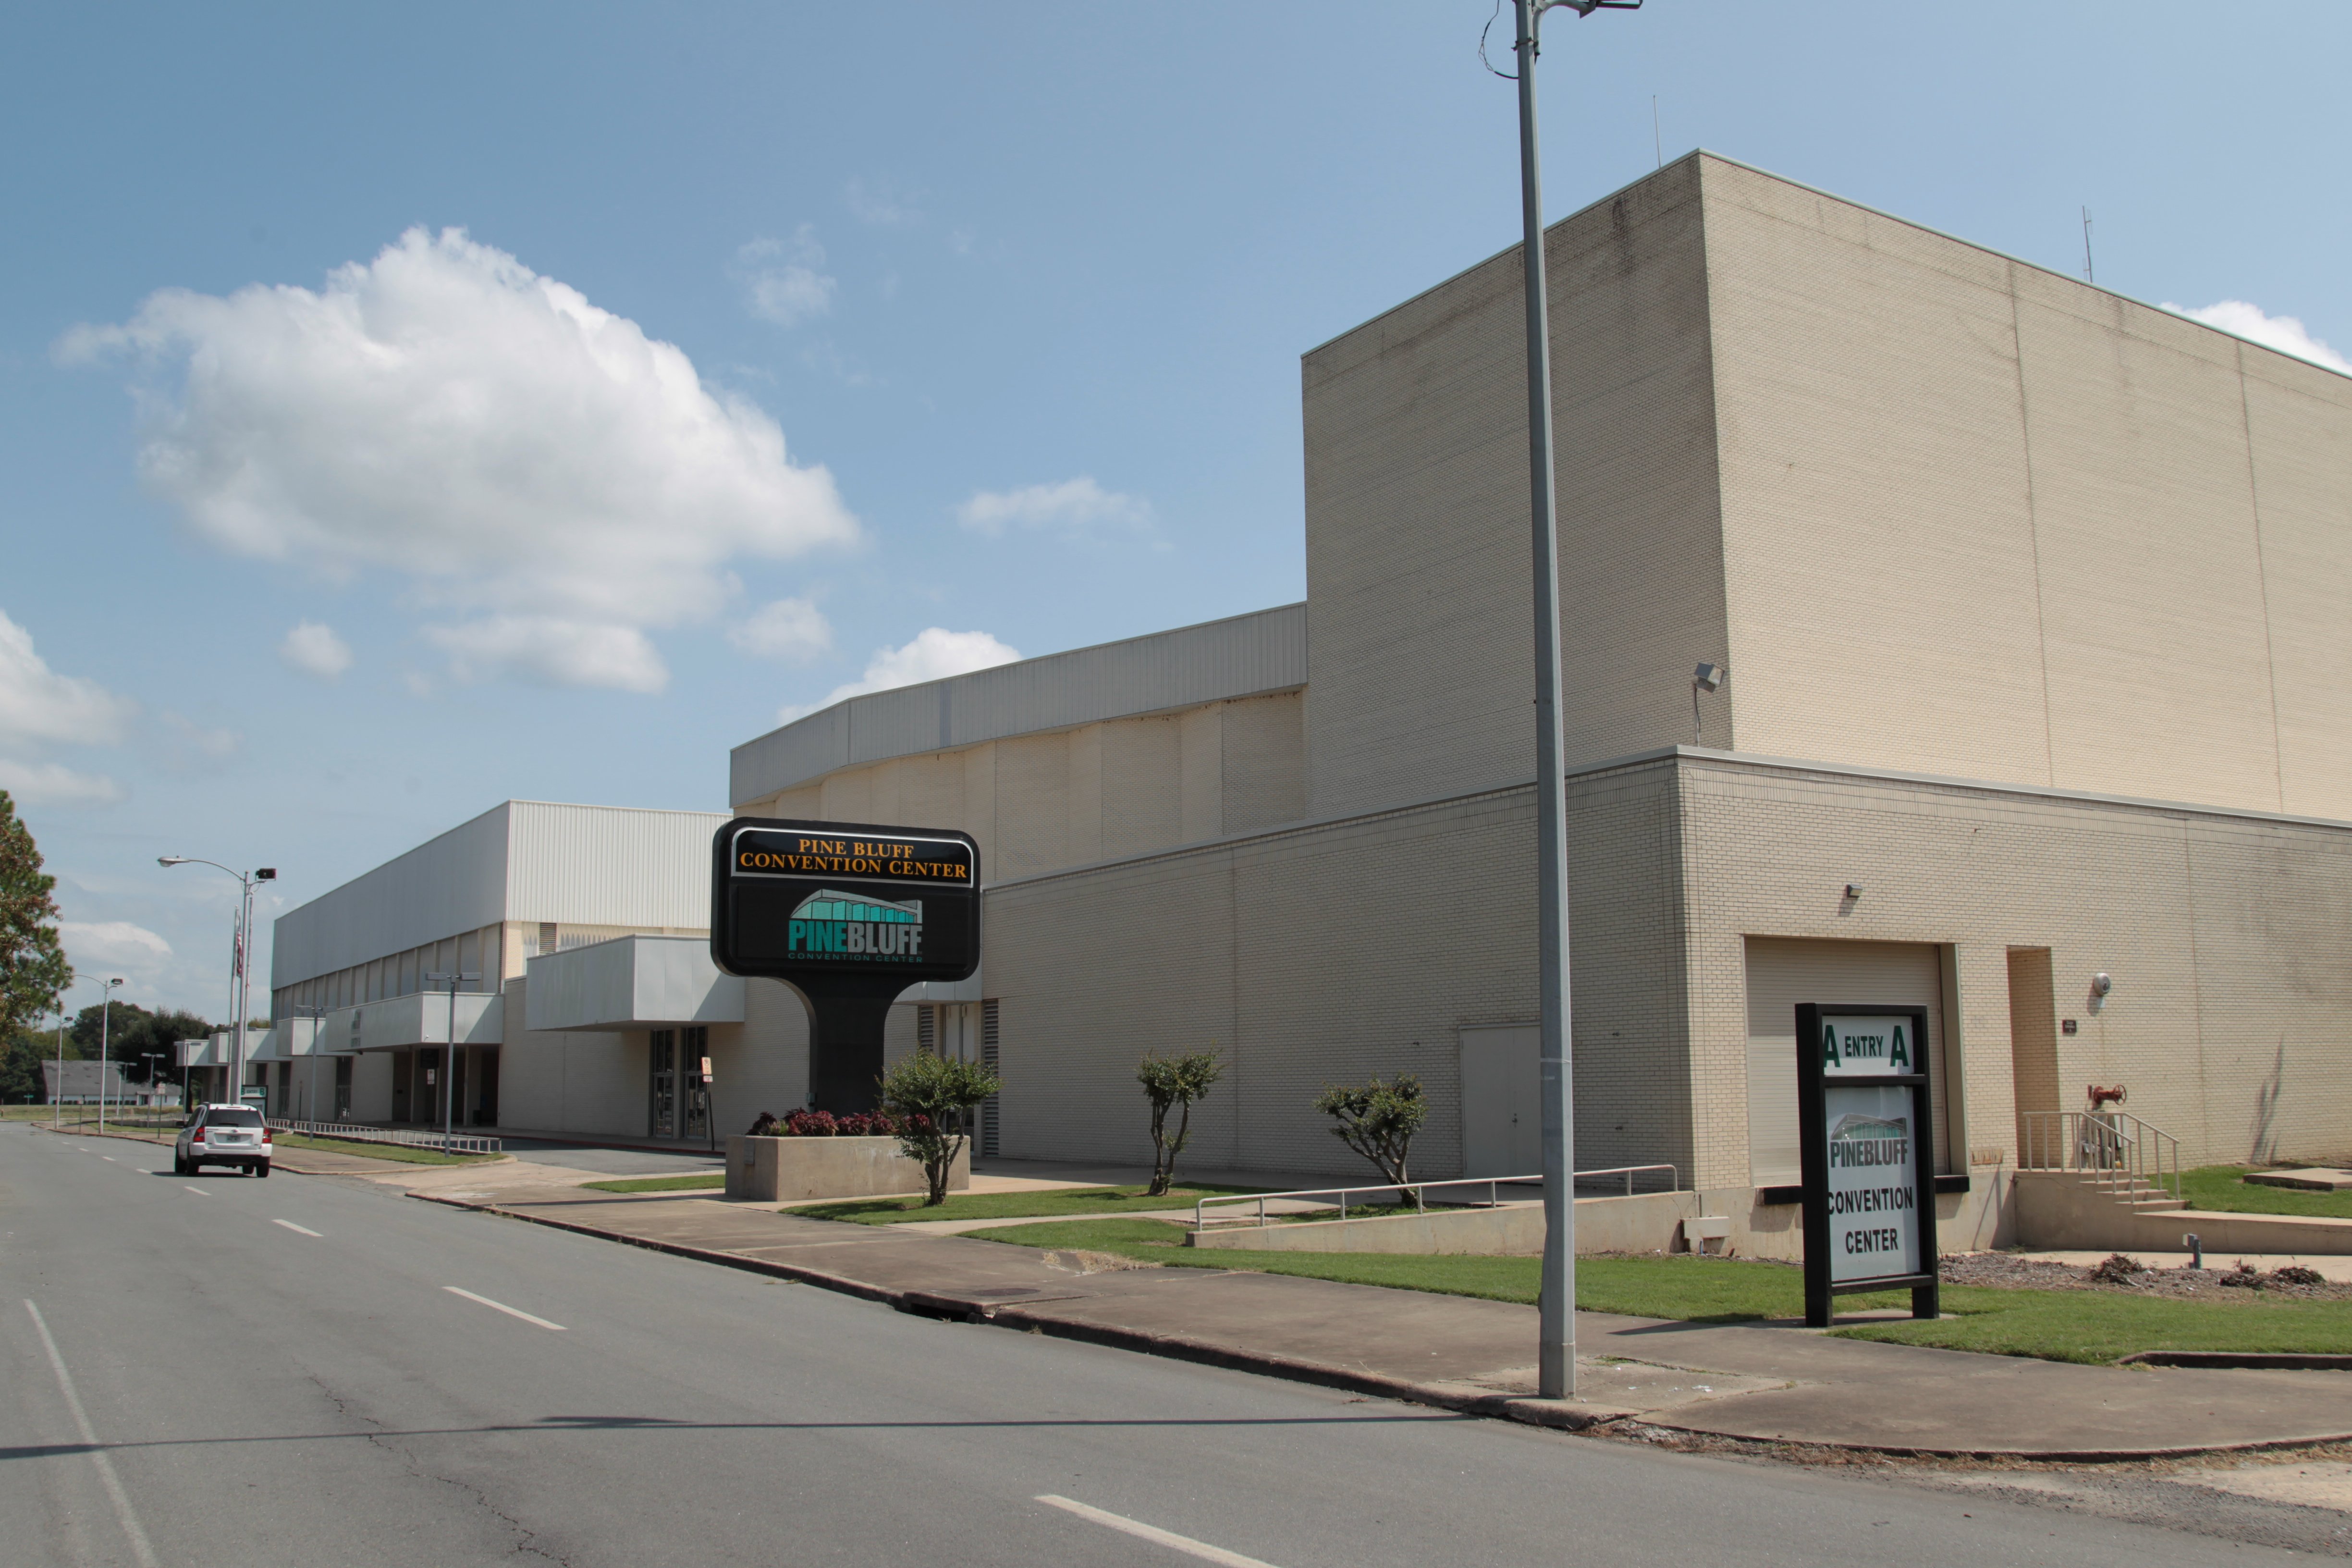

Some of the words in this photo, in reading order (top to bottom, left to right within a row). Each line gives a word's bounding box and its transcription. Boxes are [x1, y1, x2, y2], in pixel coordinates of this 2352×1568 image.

[798, 839, 846, 855] PINE
[853, 842, 914, 858] BLUFF
[740, 853, 882, 873] CONVENTION
[889, 860, 967, 878] CENTER
[788, 953, 870, 961] CONVENTION
[1823, 1025, 1841, 1067] A
[1845, 1036, 1883, 1057] ENTRY
[1890, 1025, 1909, 1066] A
[260, 1088, 265, 1096] B
[1830, 1139, 1908, 1168] PINEBLUFF
[1827, 1187, 1913, 1215] CONVENTION
[1846, 1228, 1899, 1254] CENTER
